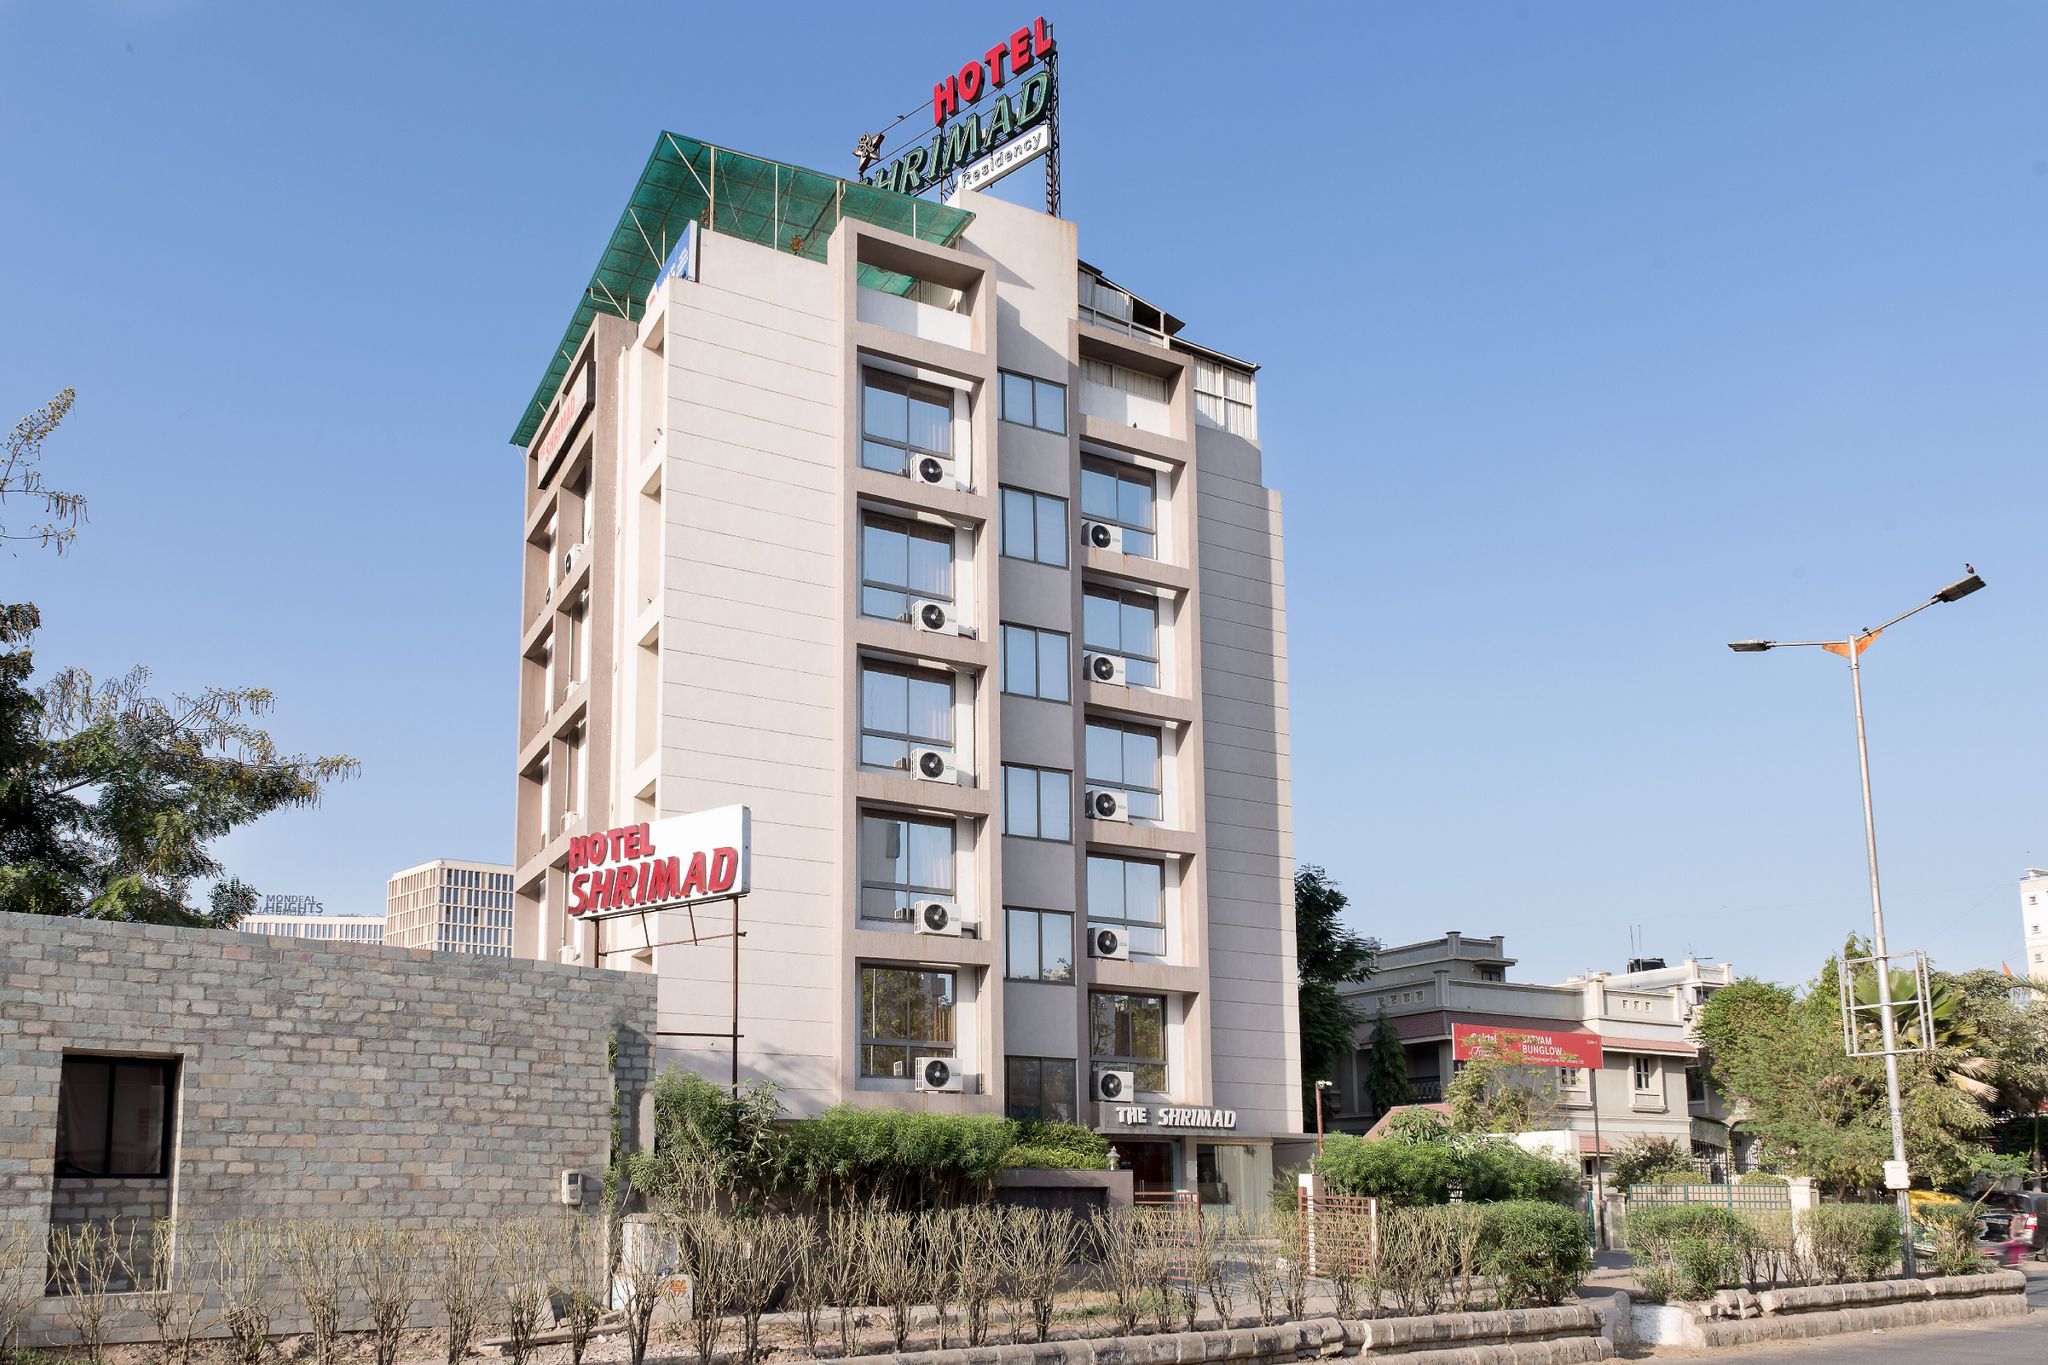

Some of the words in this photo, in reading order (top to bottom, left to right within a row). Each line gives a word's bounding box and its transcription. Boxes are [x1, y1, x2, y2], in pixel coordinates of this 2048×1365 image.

[933, 16, 1057, 128] HOTEL
[860, 71, 1054, 194] HRIMAD
[961, 132, 1042, 188] Residency
[568, 822, 656, 873] HOTEL
[266, 894, 317, 904] MONDEAL
[568, 847, 740, 917] SHRIMAD
[265, 902, 324, 914] HEIGHTS
[1522, 1044, 1562, 1055] BUNGLOW
[1115, 1106, 1147, 1125] THE
[1158, 1107, 1237, 1128] SHRIMAD
